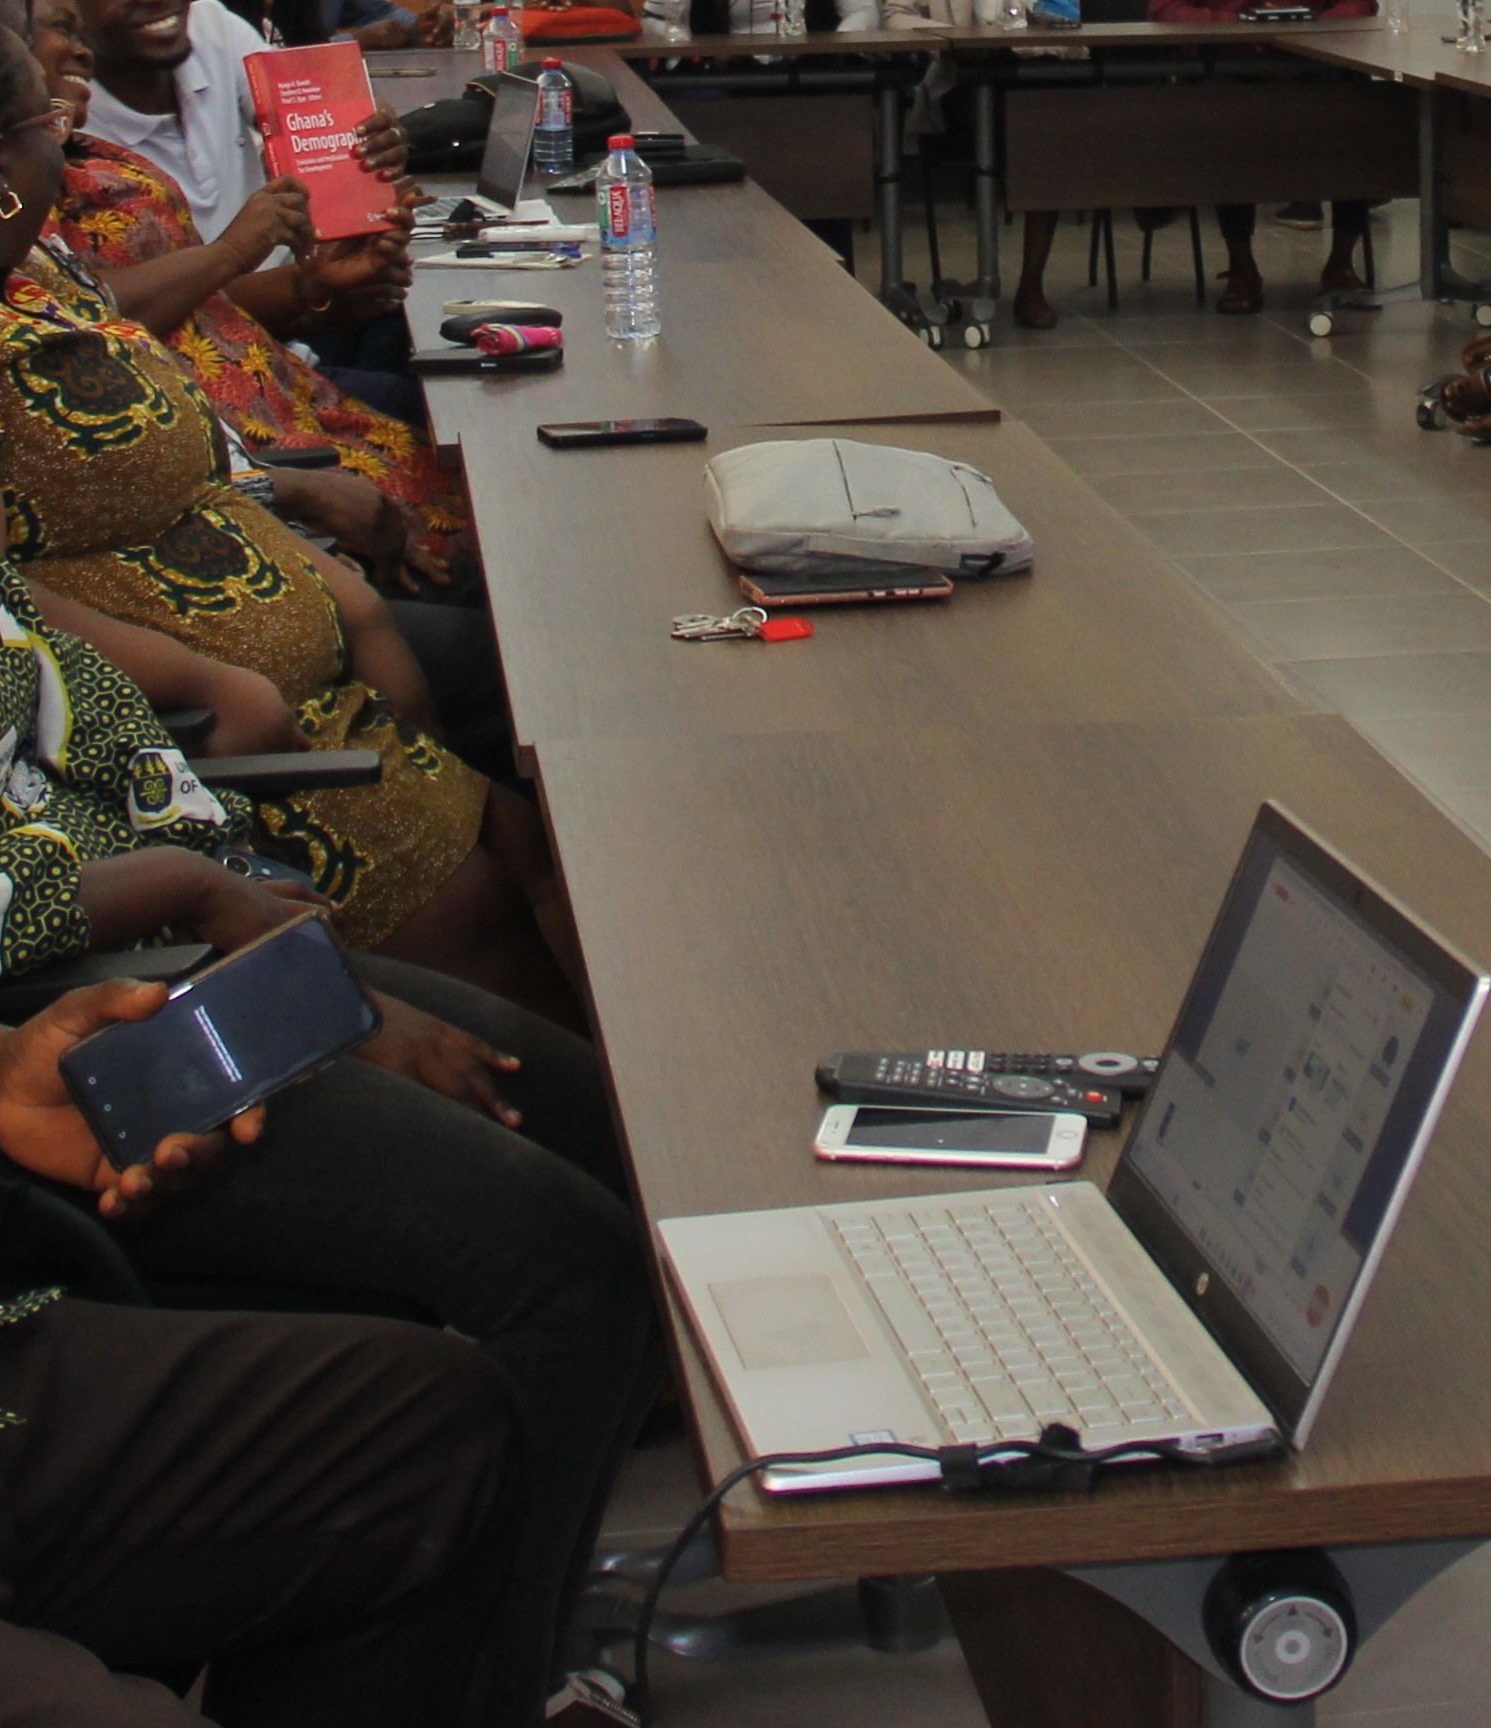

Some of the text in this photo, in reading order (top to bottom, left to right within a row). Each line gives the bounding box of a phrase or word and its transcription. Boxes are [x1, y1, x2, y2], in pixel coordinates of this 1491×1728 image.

[286, 109, 335, 132] Ghana's
[291, 127, 366, 153] Demograp
[180, 780, 198, 794] OF
